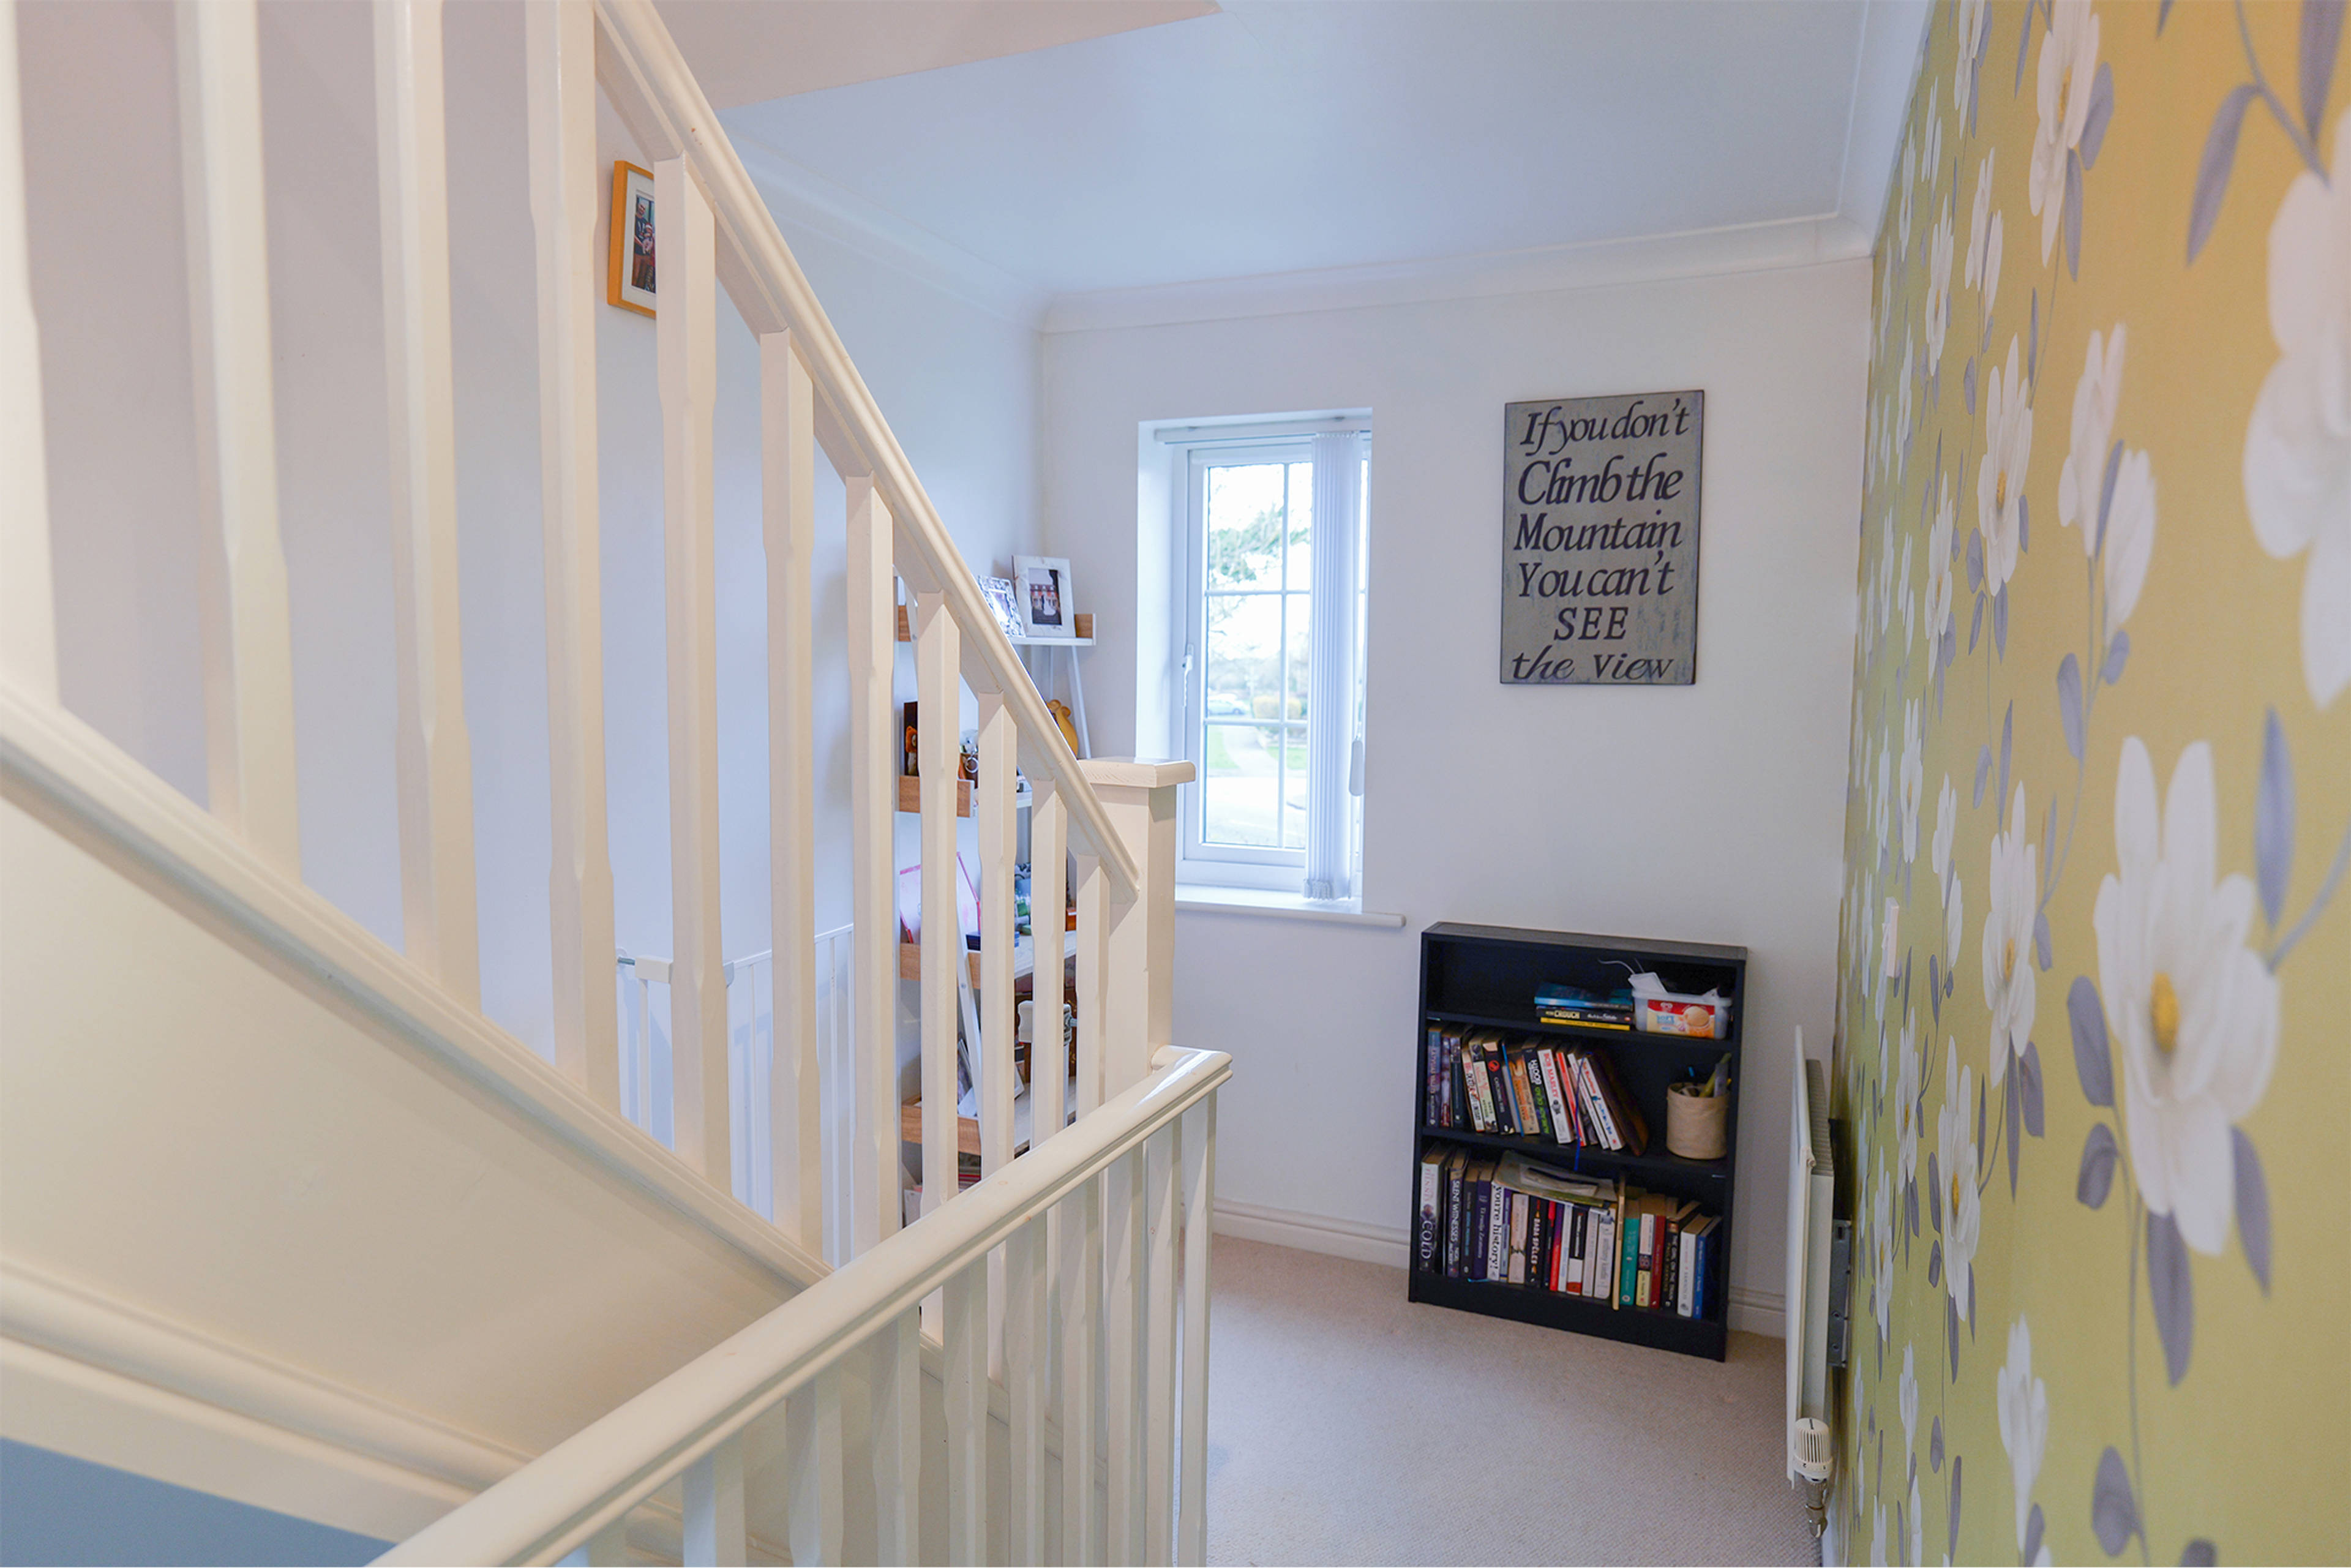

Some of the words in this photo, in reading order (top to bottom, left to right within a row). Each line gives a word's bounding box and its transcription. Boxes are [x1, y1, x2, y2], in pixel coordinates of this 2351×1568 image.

[1520, 405, 1562, 457] If
[1549, 413, 1608, 456] you
[1611, 398, 1690, 440] don't
[1517, 454, 1624, 505] Climb
[1626, 452, 1684, 501] the
[1513, 509, 1683, 552] Mountain
[1518, 562, 1583, 598] You
[1586, 550, 1675, 598] can't
[1553, 607, 1630, 641] SEE
[1512, 645, 1576, 680] the
[1543, 1052, 1552, 1067] BOB
[1547, 1068, 1559, 1098] MARLEY
[1452, 1180, 1460, 1202] SILENT
[1493, 1185, 1502, 1220] you're
[1420, 1220, 1433, 1259] COLD
[1450, 1203, 1460, 1242] WITNESSES
[1489, 1224, 1502, 1269] history!
